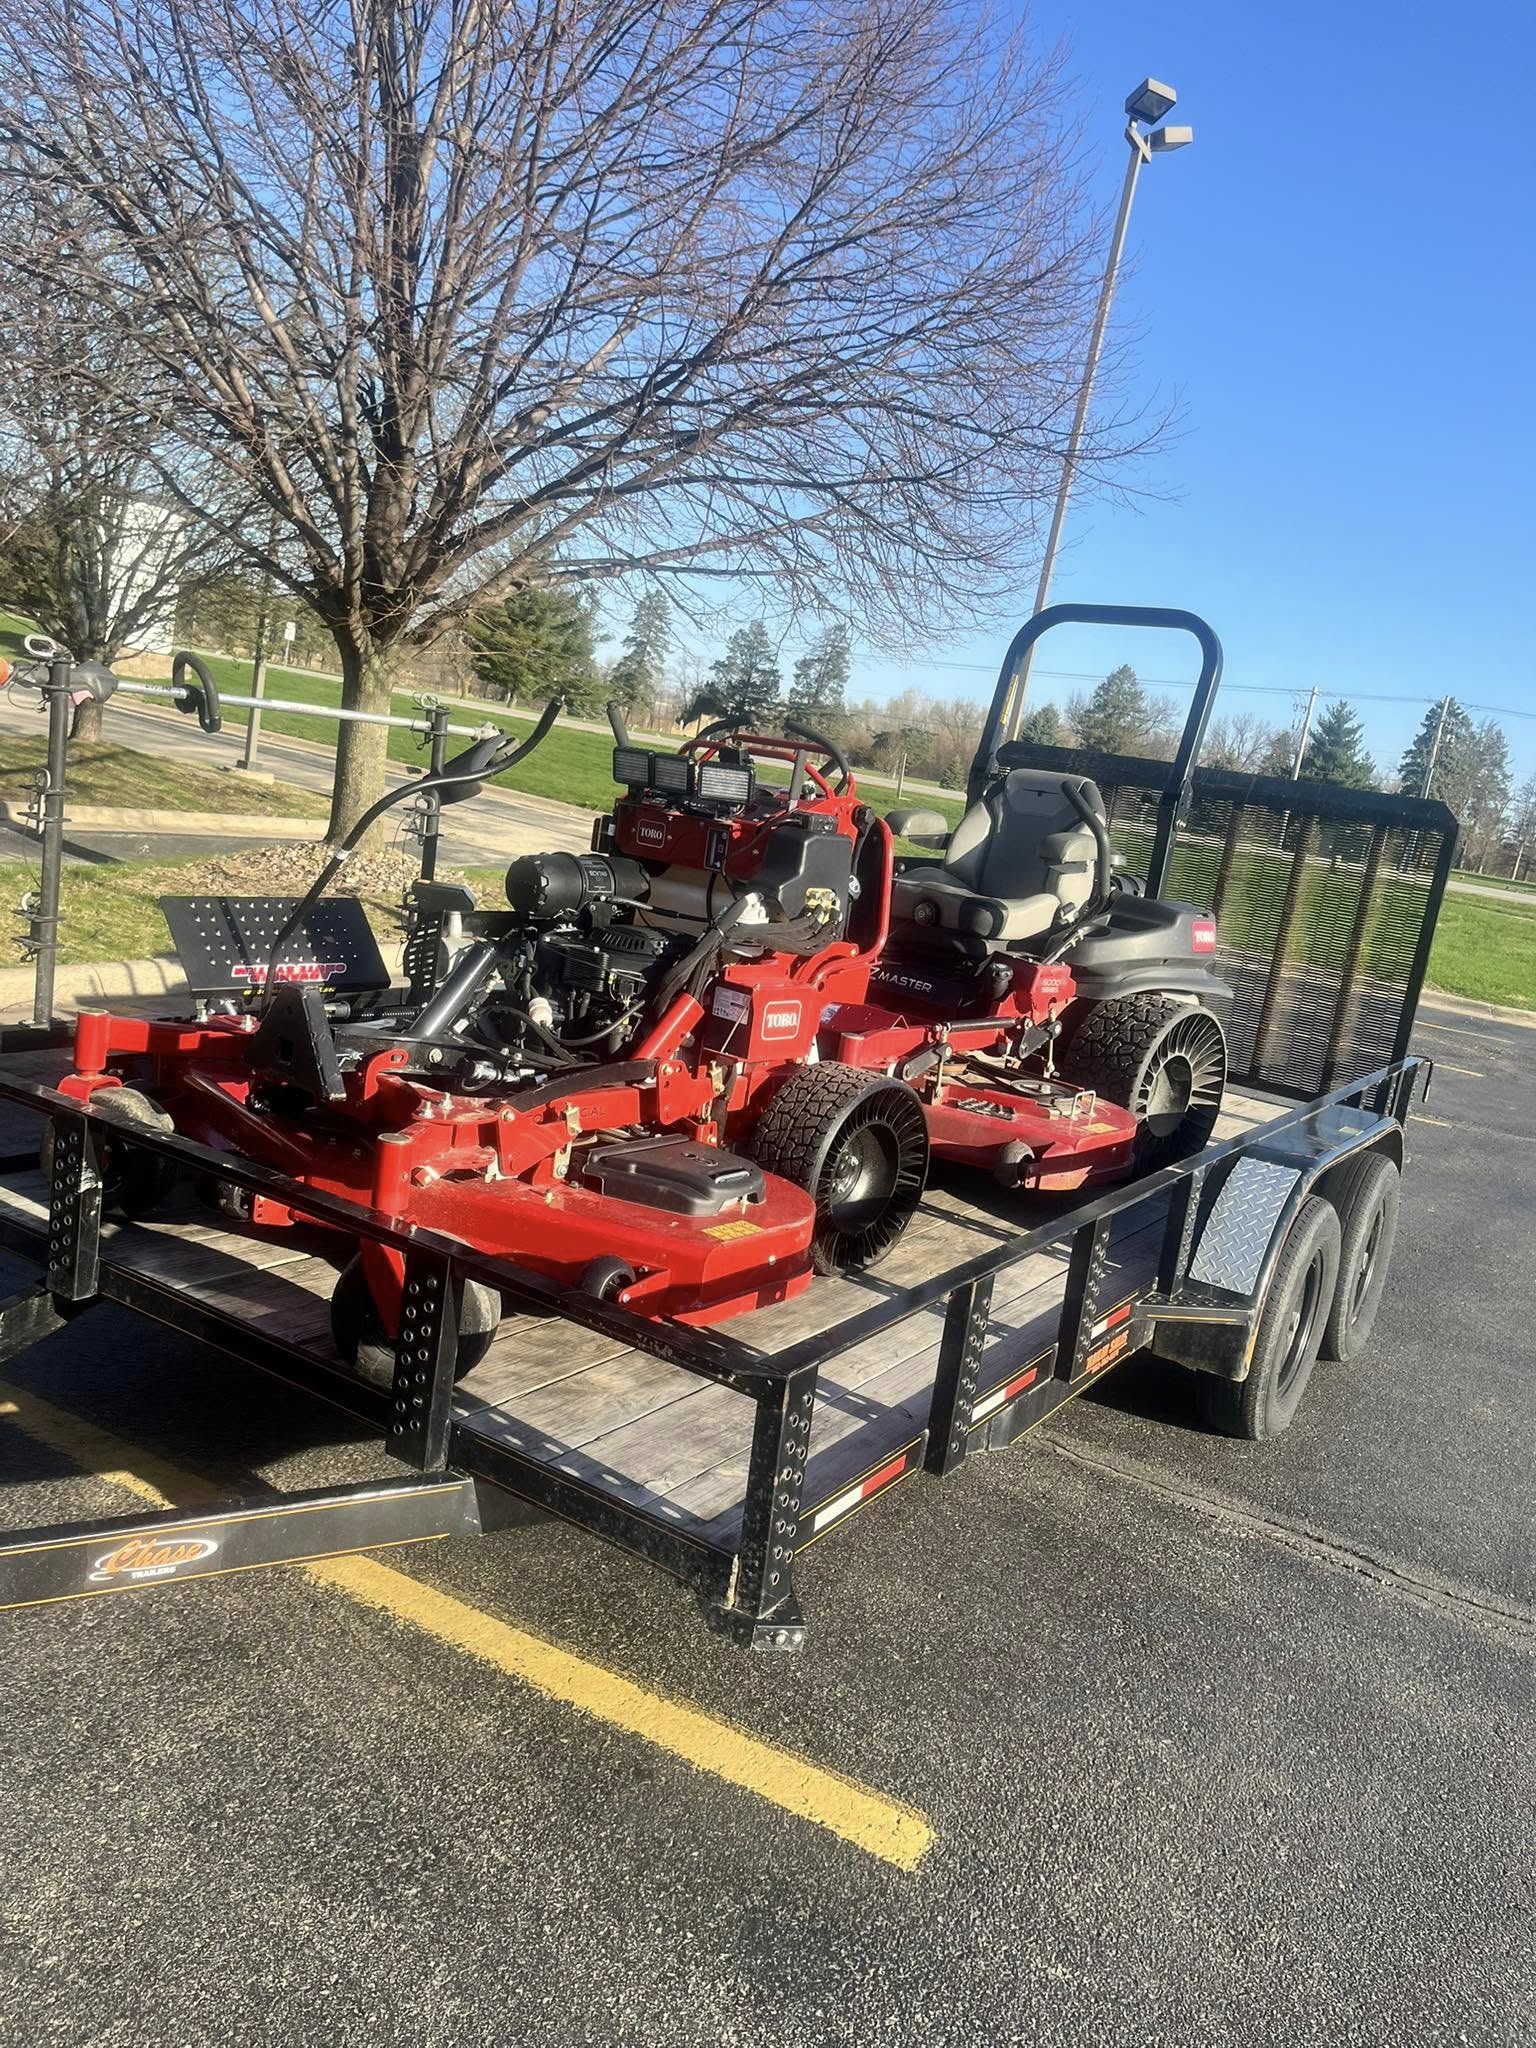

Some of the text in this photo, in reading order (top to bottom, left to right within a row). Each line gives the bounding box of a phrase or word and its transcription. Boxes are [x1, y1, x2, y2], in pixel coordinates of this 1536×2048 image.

[640, 827, 662, 840] TORO
[766, 1012, 798, 1028] TORO
[106, 1539, 202, 1573] Chase
[131, 1566, 177, 1579] TRAILERS
